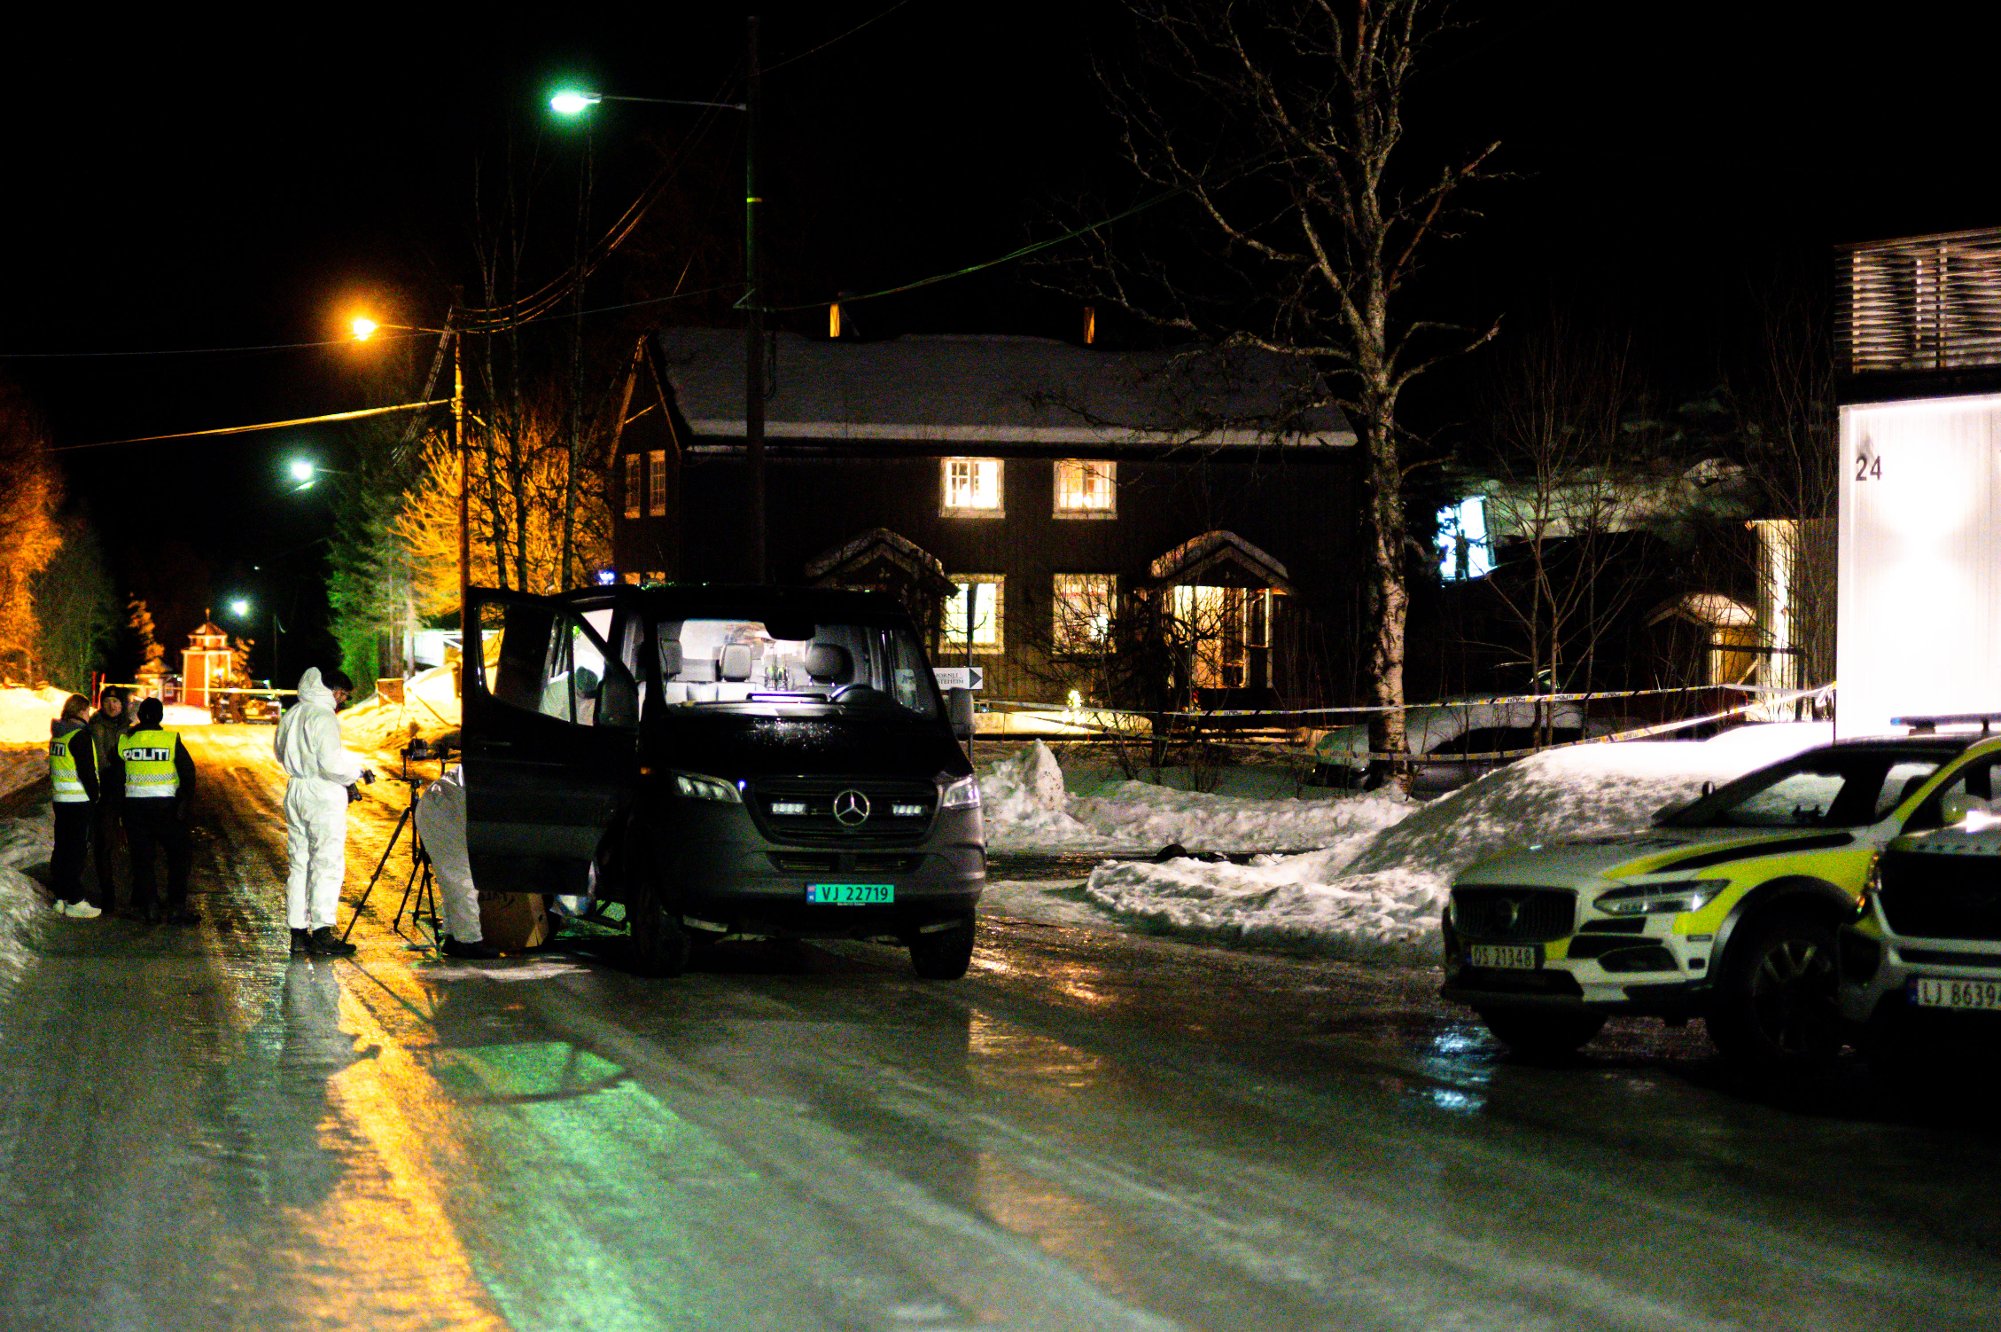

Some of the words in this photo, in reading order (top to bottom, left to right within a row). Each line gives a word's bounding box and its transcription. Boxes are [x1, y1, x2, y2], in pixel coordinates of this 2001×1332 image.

[1856, 453, 1882, 481] 24
[123, 748, 169, 761] POLITI
[822, 886, 839, 901] VJ
[846, 886, 888, 901] 22719
[1951, 983, 2001, 1007] 8639
